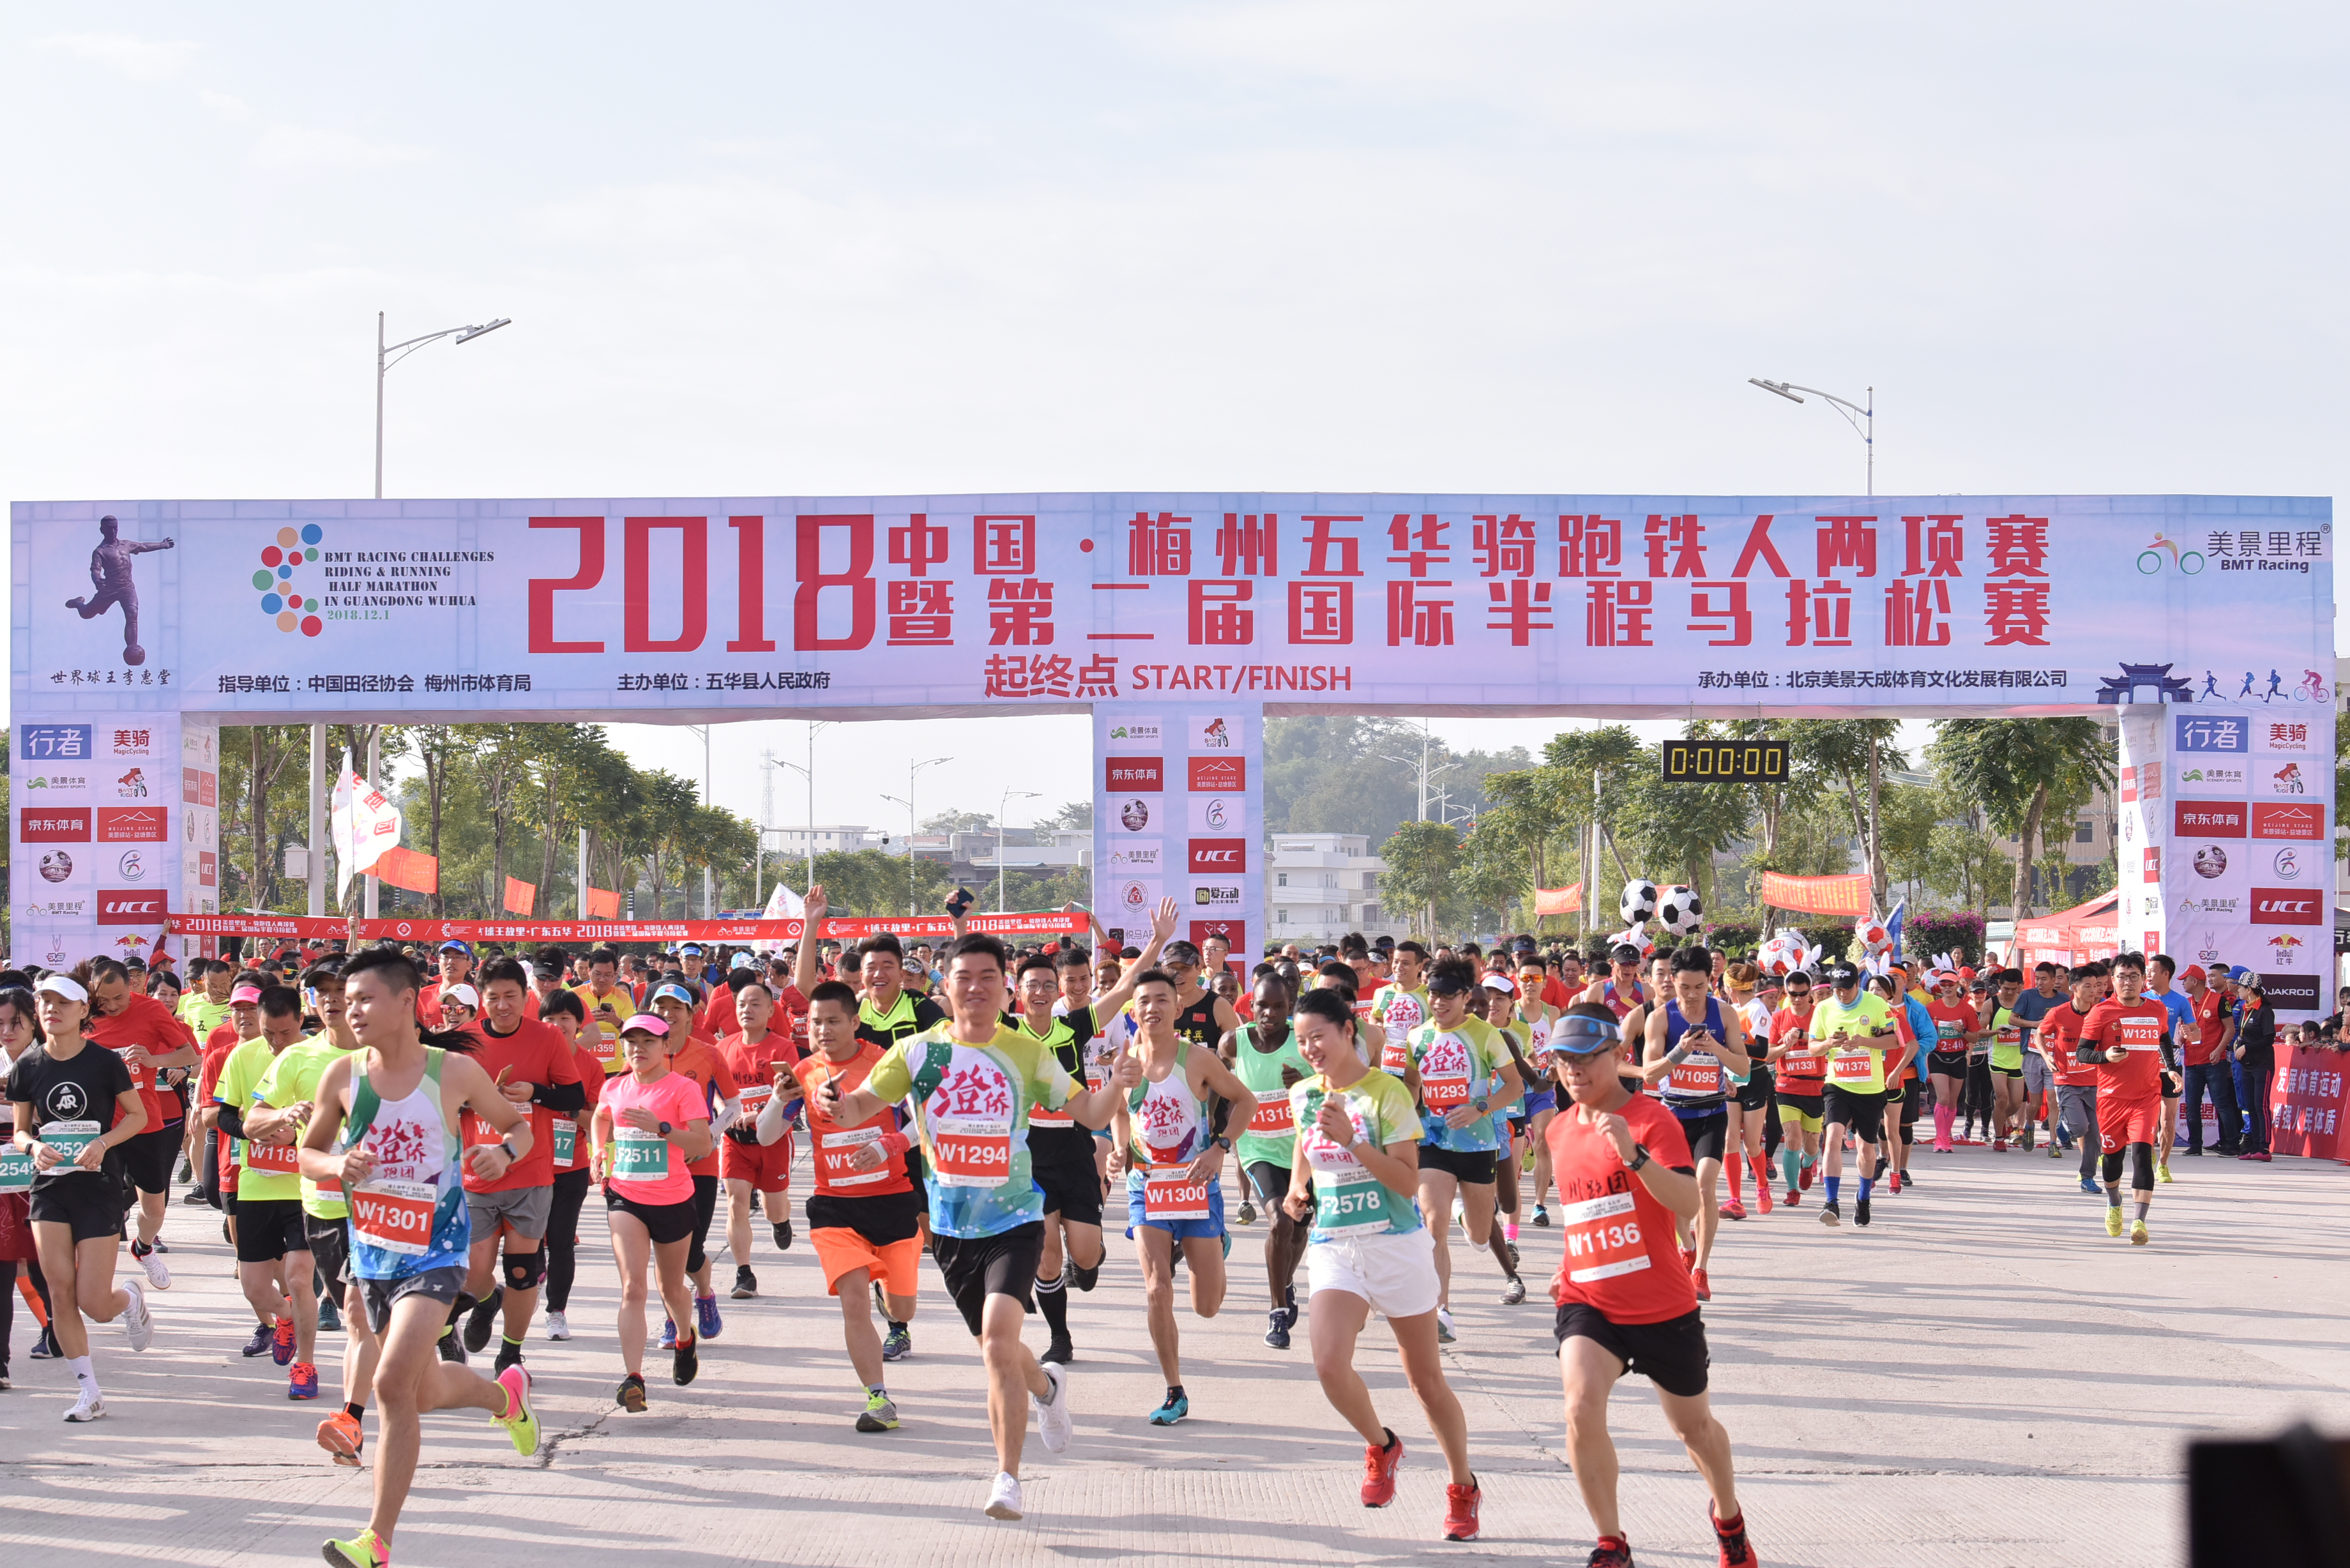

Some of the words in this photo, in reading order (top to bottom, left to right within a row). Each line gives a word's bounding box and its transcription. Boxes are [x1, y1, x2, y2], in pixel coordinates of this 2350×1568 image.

[888, 512, 2050, 578] 中国·梅州五华骑跑铁人两项赛
[2207, 531, 2323, 557] 美景里程
[324, 552, 352, 562] BMT
[357, 552, 407, 562] RACING
[411, 551, 495, 562] CHALLENGES
[324, 566, 372, 577] RIDING
[376, 566, 386, 577] &
[391, 566, 451, 577] RUNNING
[2221, 559, 2255, 570] BMT
[2258, 559, 2309, 573] Racing
[329, 581, 362, 592] HALF
[366, 581, 438, 591] MARATHON
[528, 514, 876, 654] 2018
[324, 596, 338, 607] IN
[344, 596, 423, 607] GUANGDONG
[428, 596, 476, 606] WUHUA
[327, 610, 390, 620] 2018.12.1
[886, 578, 2051, 647] 暨第二届国际半程马拉松赛
[50, 668, 171, 686] 世界球王李惠堂
[617, 672, 831, 692] 主办单位：五华县人民政府
[984, 653, 1119, 698] 起终点
[1132, 665, 1353, 694] START/FINISH
[1698, 670, 2068, 690] 承办单位：北京美景天成体育文化发展有限公司
[218, 674, 414, 694] 指导单位：中国田径协会
[424, 674, 533, 693] 梅州市体育局
[114, 729, 150, 748] 美骑
[2184, 720, 2240, 748] 行者
[2270, 723, 2307, 742] 美骑
[29, 728, 84, 756] 行者
[2269, 742, 2306, 750] MagicCycling
[114, 748, 149, 756] MagicCycling
[1671, 748, 1782, 775] 0:00:00
[1112, 769, 1157, 780] 京东体育
[2206, 769, 2242, 778] 美景体育
[51, 776, 86, 785] 美景体育
[29, 819, 84, 831] 京东体育
[2183, 813, 2240, 826] 京东体育
[1128, 850, 1156, 859] 美景里程
[1195, 850, 1239, 861] UCC
[47, 902, 83, 911] 美景里程
[105, 901, 159, 913] UCC
[2201, 898, 2237, 907] 美景里程
[2259, 900, 2314, 913] UCC
[186, 918, 222, 931] 2018
[577, 925, 612, 937] 2018
[2276, 949, 2293, 958] RedBull
[2276, 958, 2293, 966] 红牛
[2123, 1029, 2158, 1039] W1213
[1941, 1039, 1964, 1051] 2:40
[1786, 1060, 1817, 1071] W1331
[1835, 1060, 1870, 1072] W1379
[1672, 1067, 1718, 1083] W1095
[2277, 1066, 2342, 1098] 发展体育运动
[1423, 1084, 1467, 1099] W1293
[2271, 1102, 2336, 1135] 增强人民体质
[1156, 1128, 1179, 1138] 跑团
[250, 1143, 300, 1163] W118
[618, 1147, 660, 1163] F2511
[937, 1142, 1008, 1165] W1294
[383, 1165, 414, 1180] 跑团
[1146, 1186, 1206, 1203] W1300
[1320, 1191, 1381, 1216] F2578
[354, 1200, 428, 1232] W1301
[1568, 1222, 1641, 1257] W1136
